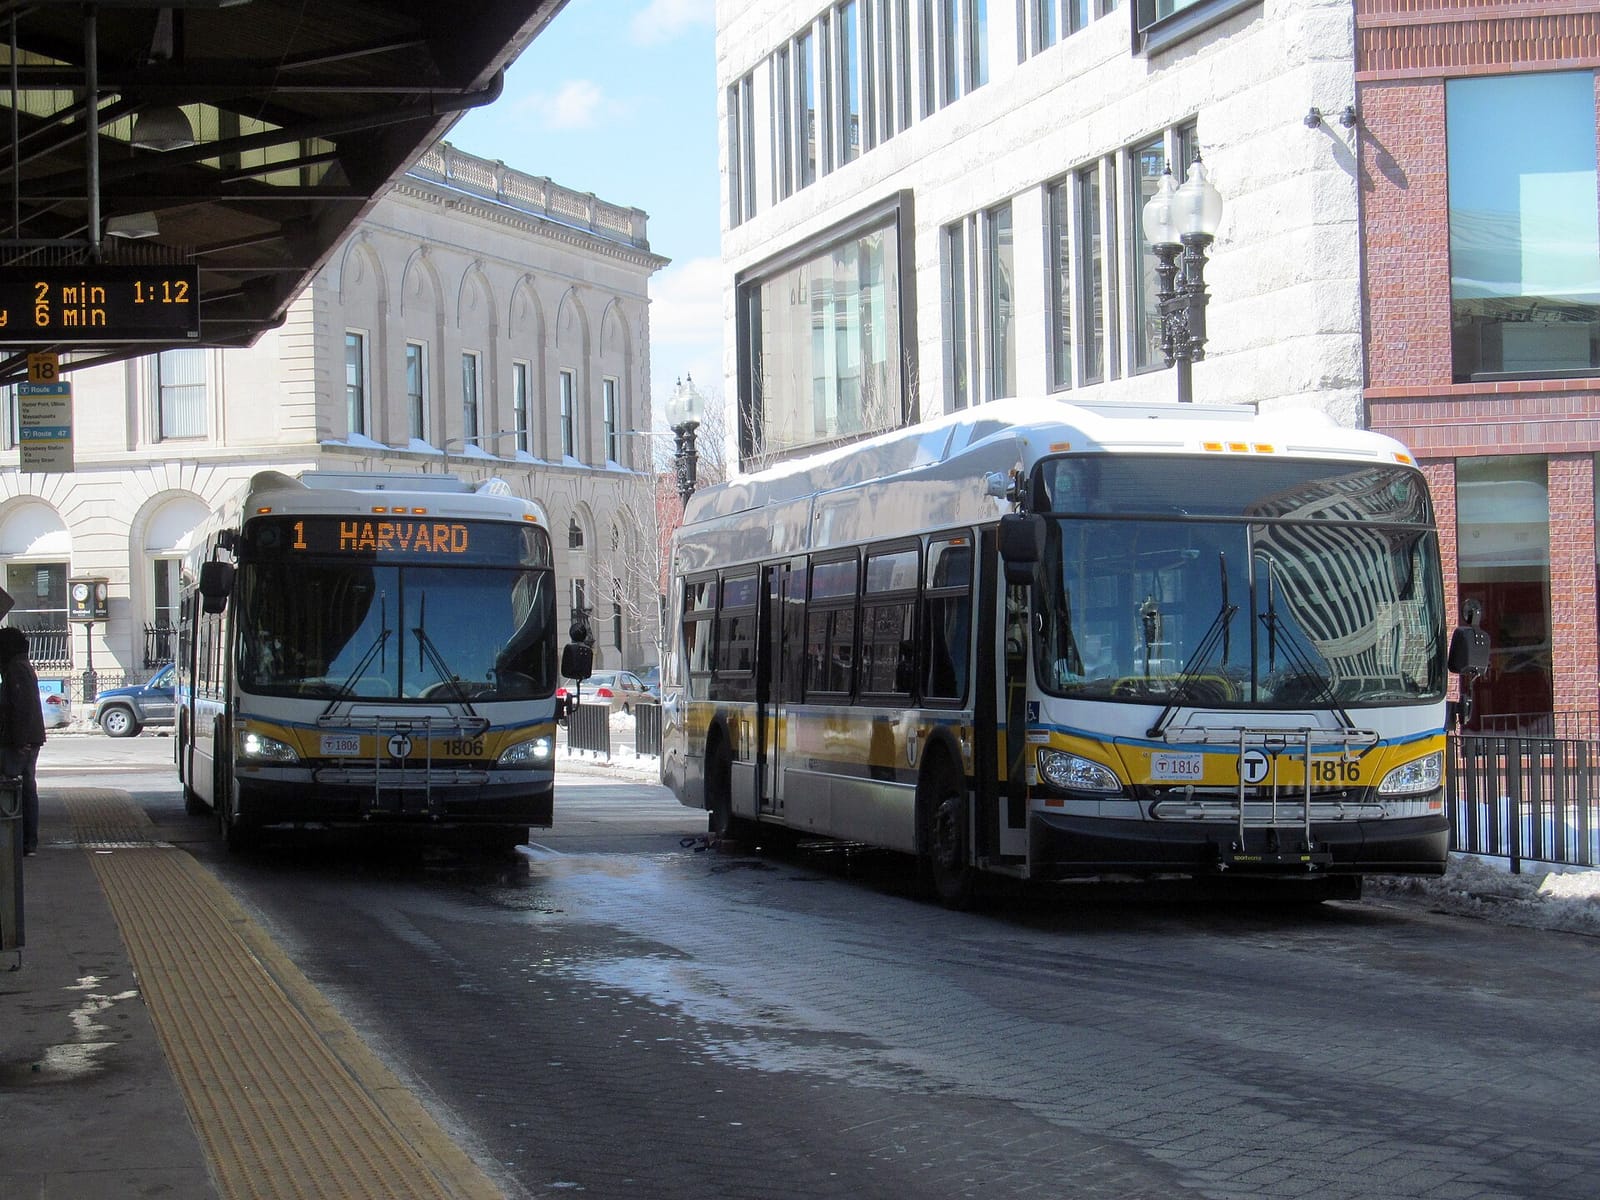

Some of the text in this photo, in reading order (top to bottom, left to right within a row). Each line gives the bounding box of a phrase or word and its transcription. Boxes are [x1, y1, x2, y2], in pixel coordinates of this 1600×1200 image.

[34, 282, 105, 304] 2 min
[134, 281, 189, 303] 1:12
[35, 305, 50, 327] 6
[63, 304, 106, 326] min
[32, 363, 54, 379] 18
[293, 521, 469, 553] 1 HARVARD
[335, 740, 358, 751] 1806
[443, 740, 484, 756] 1806
[1171, 760, 1200, 774] 1816
[1312, 760, 1360, 781] 1816
